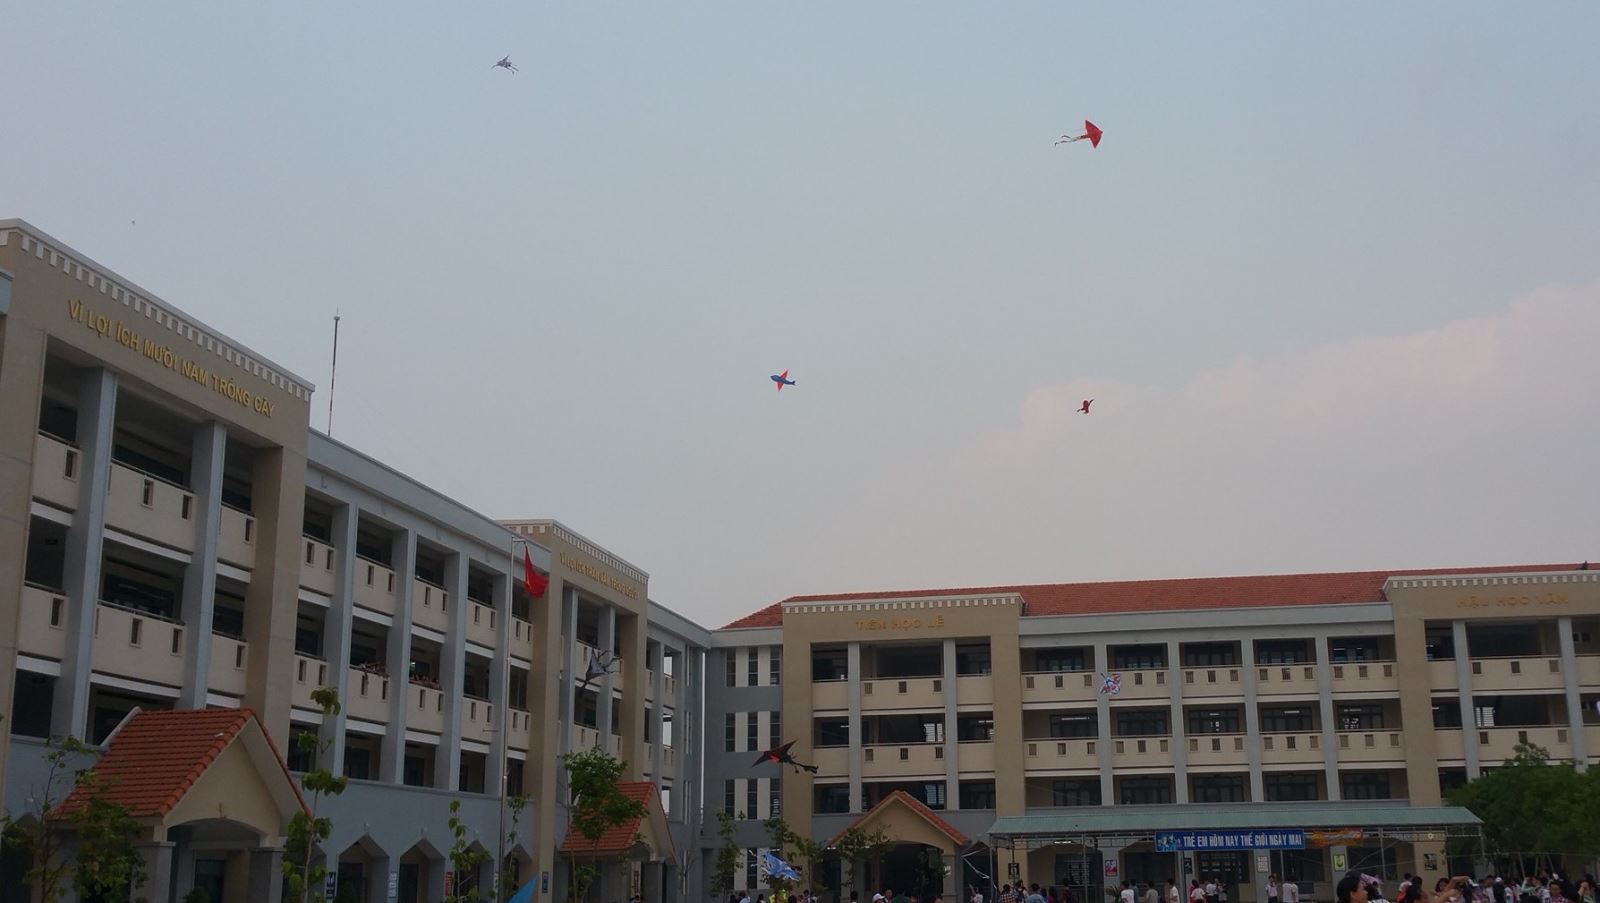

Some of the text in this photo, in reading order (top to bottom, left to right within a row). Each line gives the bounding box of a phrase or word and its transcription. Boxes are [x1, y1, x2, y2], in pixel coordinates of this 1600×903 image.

[68, 299, 84, 322] VÌ
[87, 309, 112, 337] LỢI
[116, 320, 139, 351] ÍCH
[143, 338, 178, 371] MƯỜI
[1197, 835, 1209, 847] EM
[1225, 835, 1239, 847] NAY
